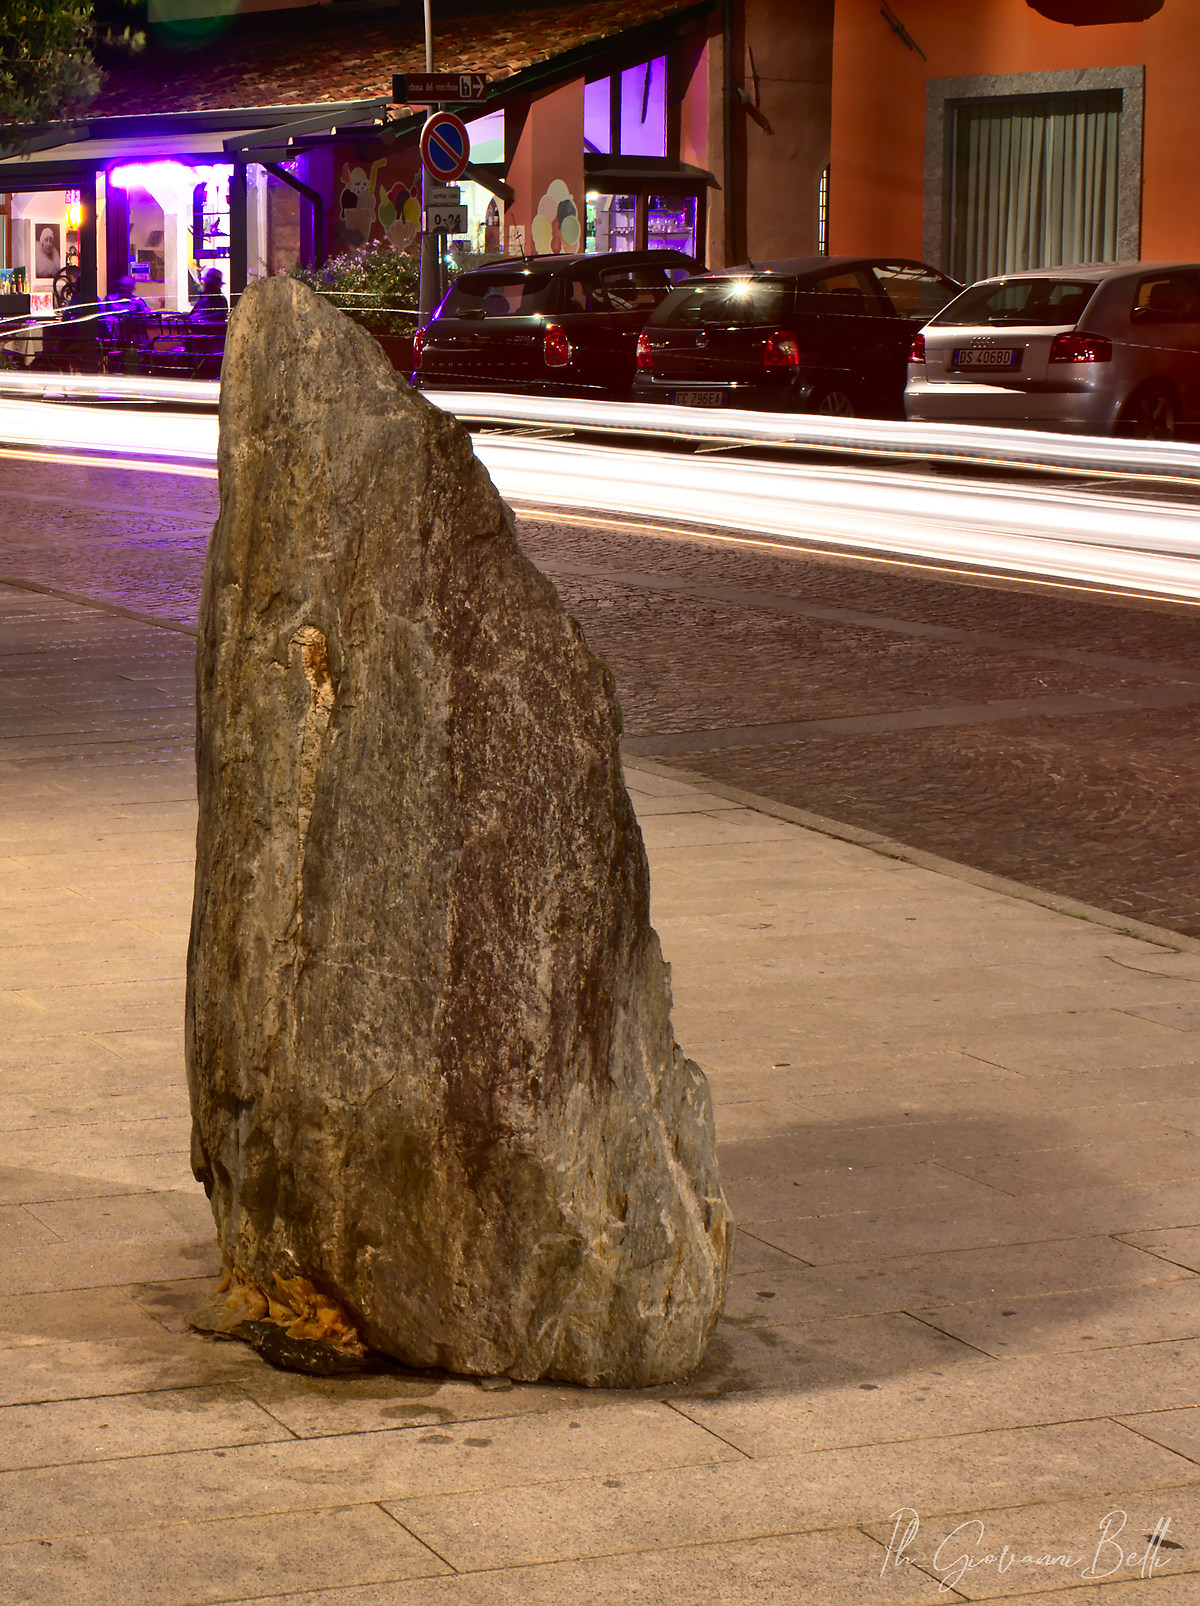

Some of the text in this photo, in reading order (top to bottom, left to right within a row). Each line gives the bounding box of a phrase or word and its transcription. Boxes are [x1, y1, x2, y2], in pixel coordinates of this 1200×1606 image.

[959, 350, 1011, 364] DS 406BD
[676, 392, 721, 406] CC 796EA
